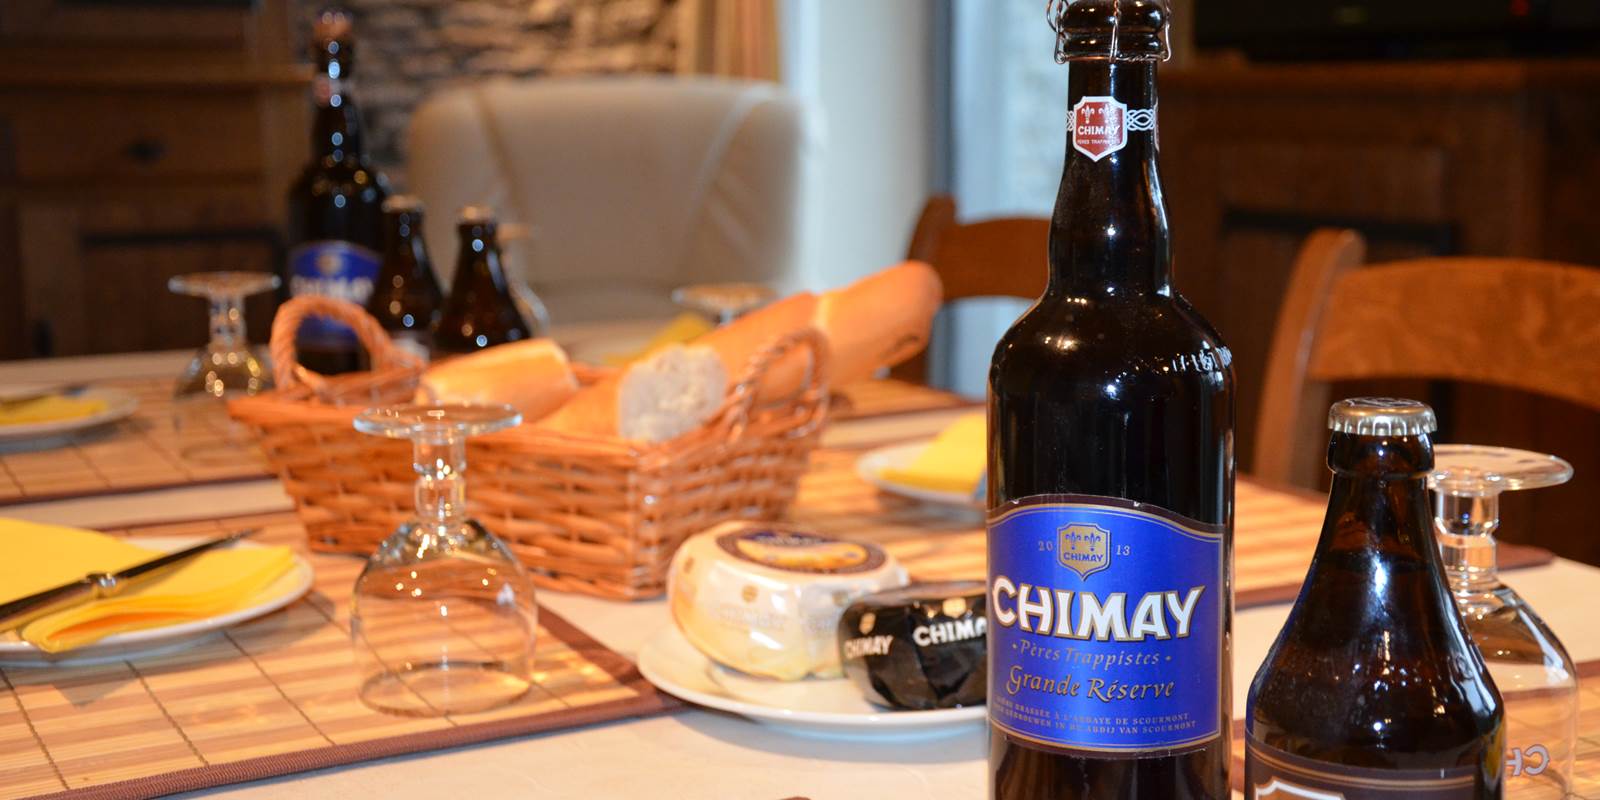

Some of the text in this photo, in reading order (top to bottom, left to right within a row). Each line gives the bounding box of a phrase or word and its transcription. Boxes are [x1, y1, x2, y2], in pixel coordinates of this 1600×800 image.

[1077, 125, 1121, 135] CHIMAY
[1037, 540, 1054, 552] 20
[1115, 544, 1131, 556] 13
[1063, 551, 1104, 563] CHIMAY
[992, 574, 1206, 641] CHIMAY
[844, 634, 894, 659] CHIMAY
[1020, 638, 1160, 671] Pères Trappistes
[1006, 664, 1176, 703] Grande Réserve
[1115, 717, 1129, 725] DE
[1119, 726, 1139, 735] VAN
